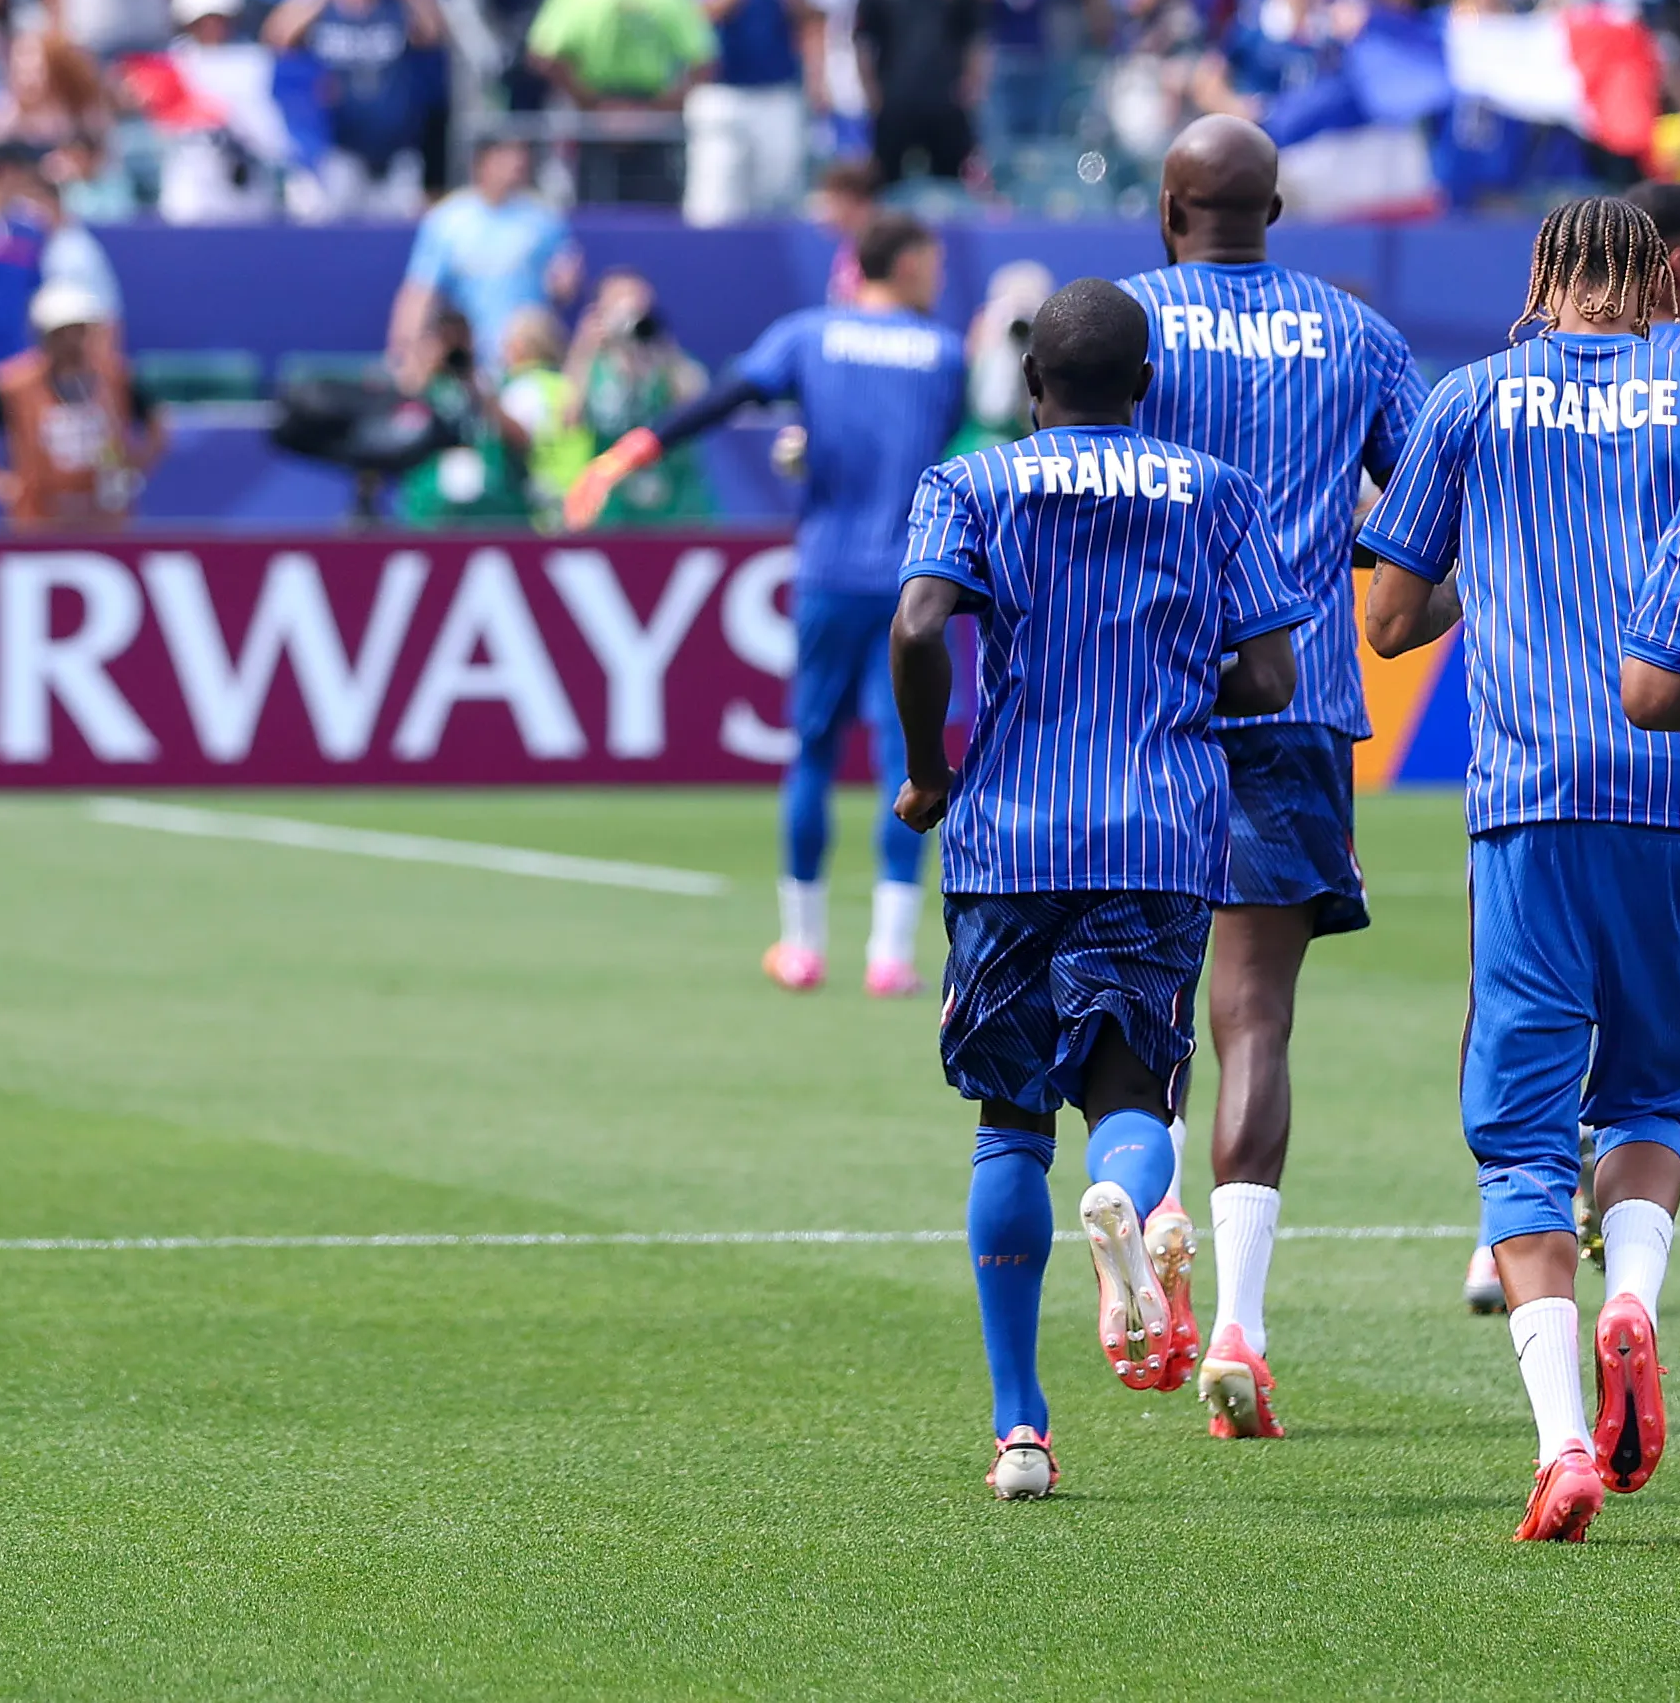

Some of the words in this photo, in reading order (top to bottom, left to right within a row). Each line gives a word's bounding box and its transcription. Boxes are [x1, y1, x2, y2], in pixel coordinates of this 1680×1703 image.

[1161, 304, 1326, 359] FRANCE
[1498, 375, 1678, 435] FRANCE
[1012, 448, 1194, 505] FRANCE
